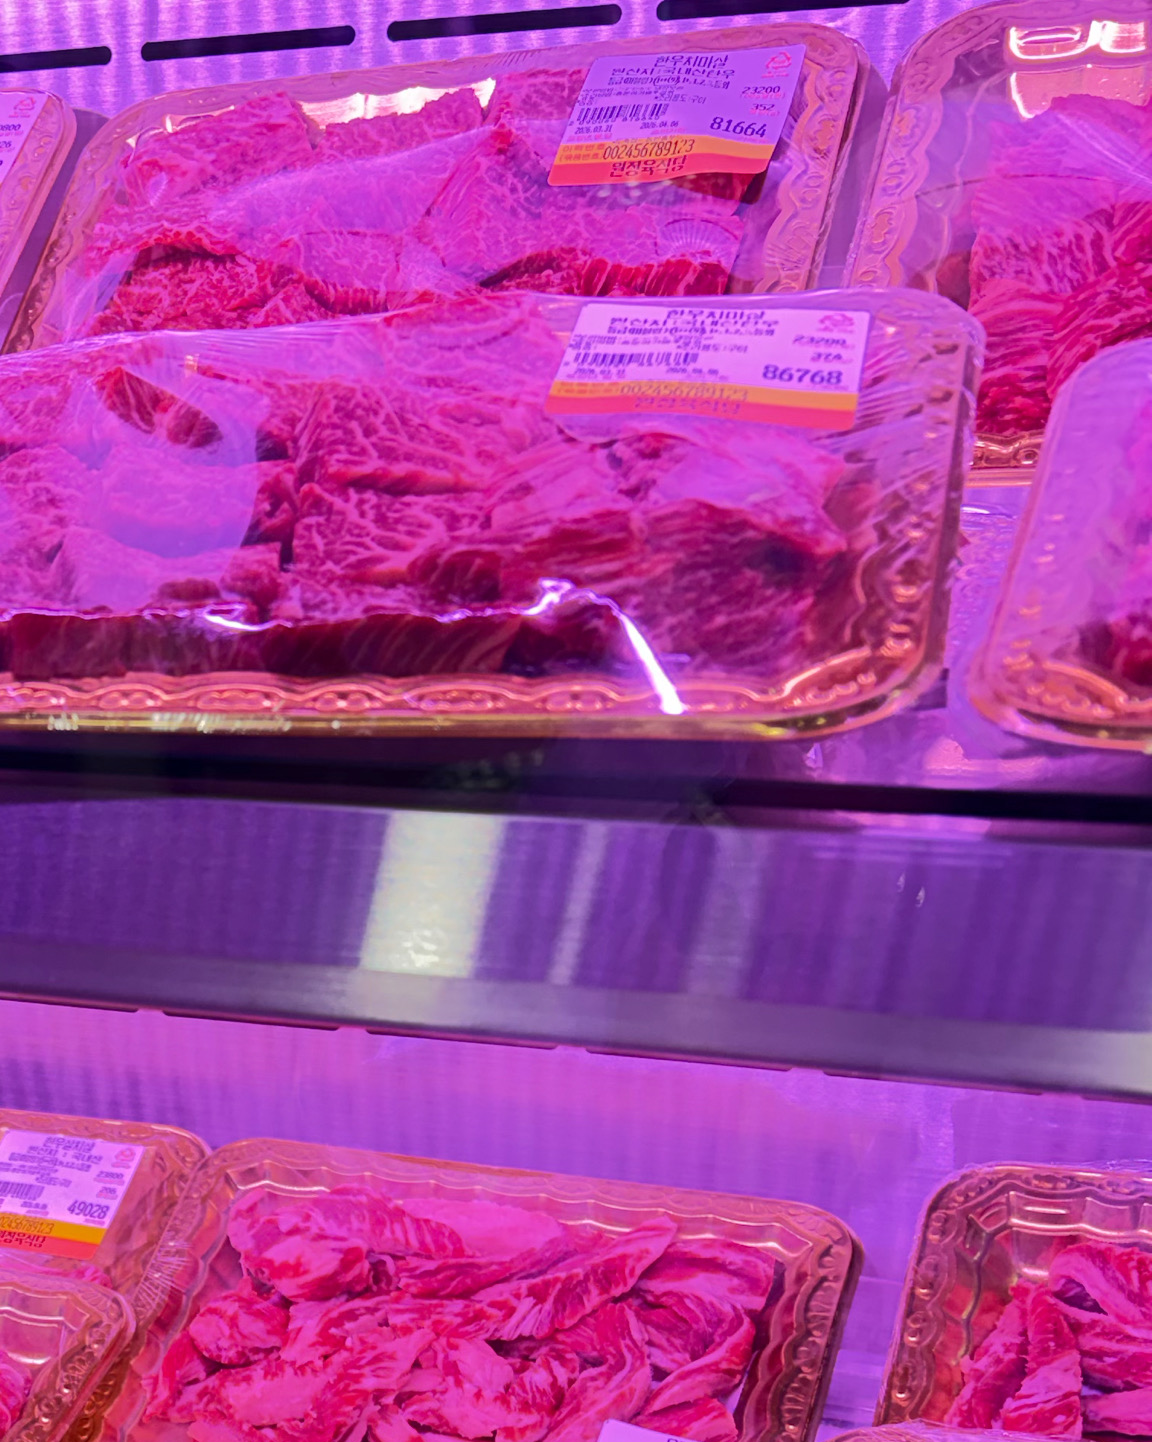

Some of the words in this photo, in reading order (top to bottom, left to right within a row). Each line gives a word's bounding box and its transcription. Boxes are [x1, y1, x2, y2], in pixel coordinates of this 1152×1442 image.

[655, 55, 728, 68] 한우치마살
[742, 85, 780, 94] 23200
[710, 117, 767, 138] 81664
[603, 139, 695, 160] 002456789123
[610, 155, 687, 178] 원정육식당
[762, 364, 844, 386] 86768
[67, 1200, 110, 1219] 49028
